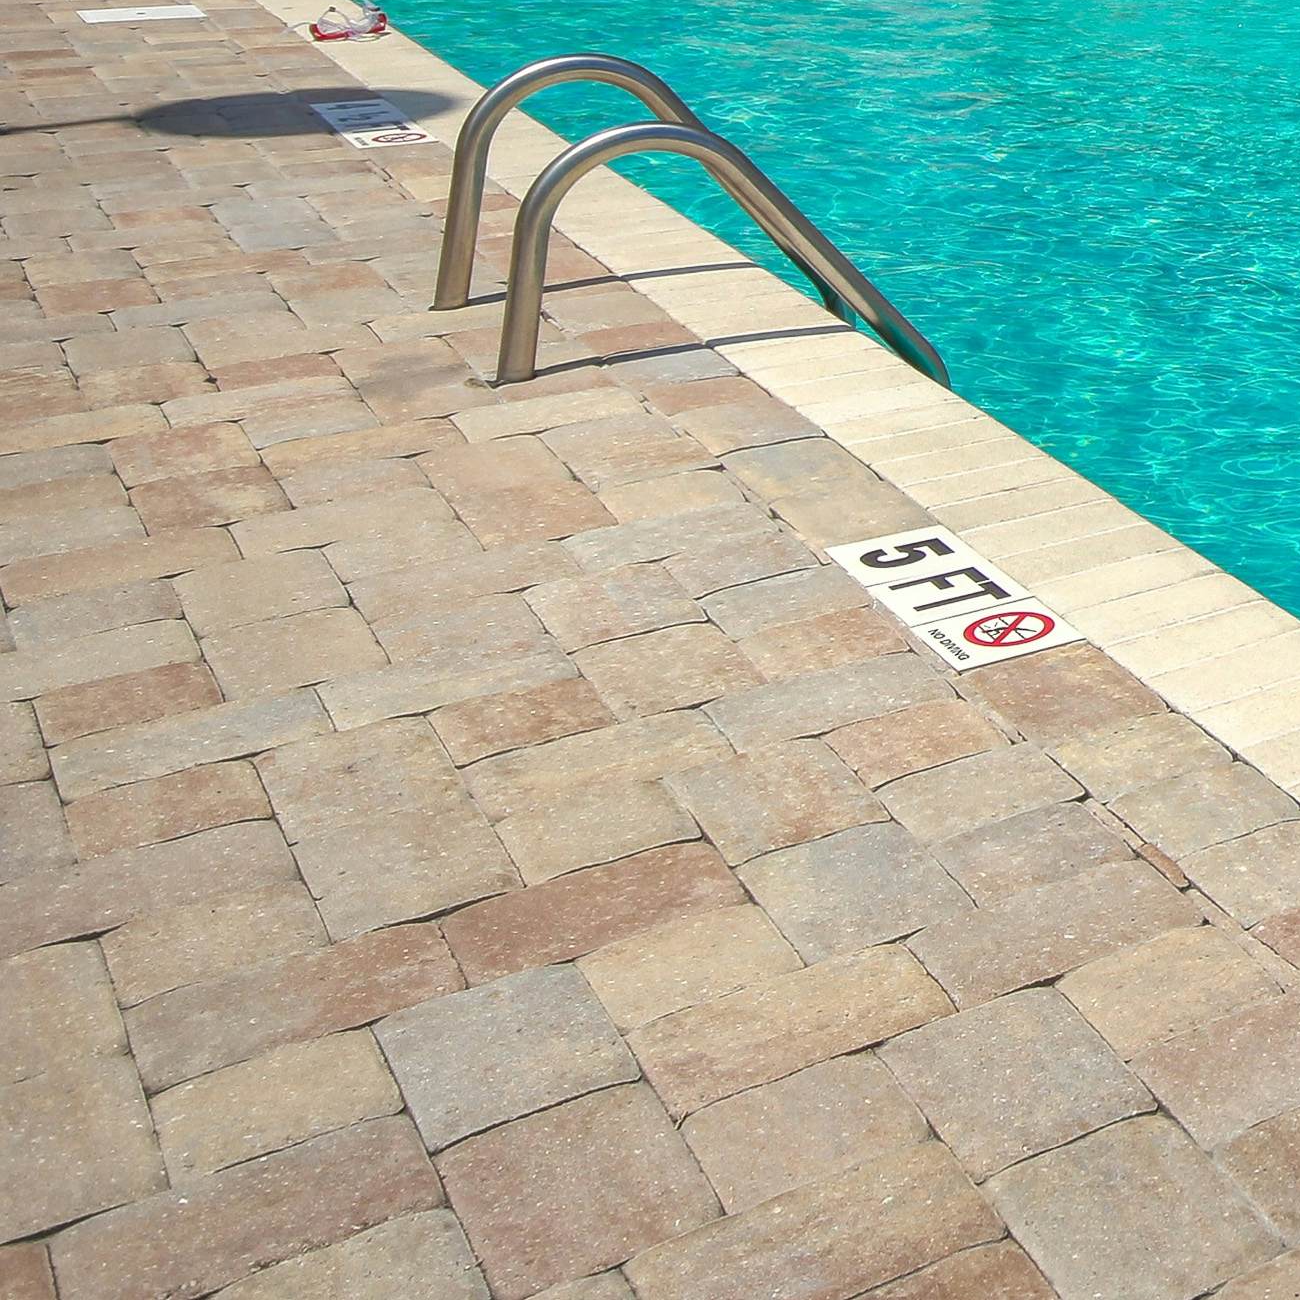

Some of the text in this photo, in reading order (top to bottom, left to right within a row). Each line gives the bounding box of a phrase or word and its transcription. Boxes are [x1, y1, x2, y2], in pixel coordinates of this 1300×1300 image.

[859, 537, 1012, 612] 5 FT
[927, 628, 971, 661] NO DIVING
